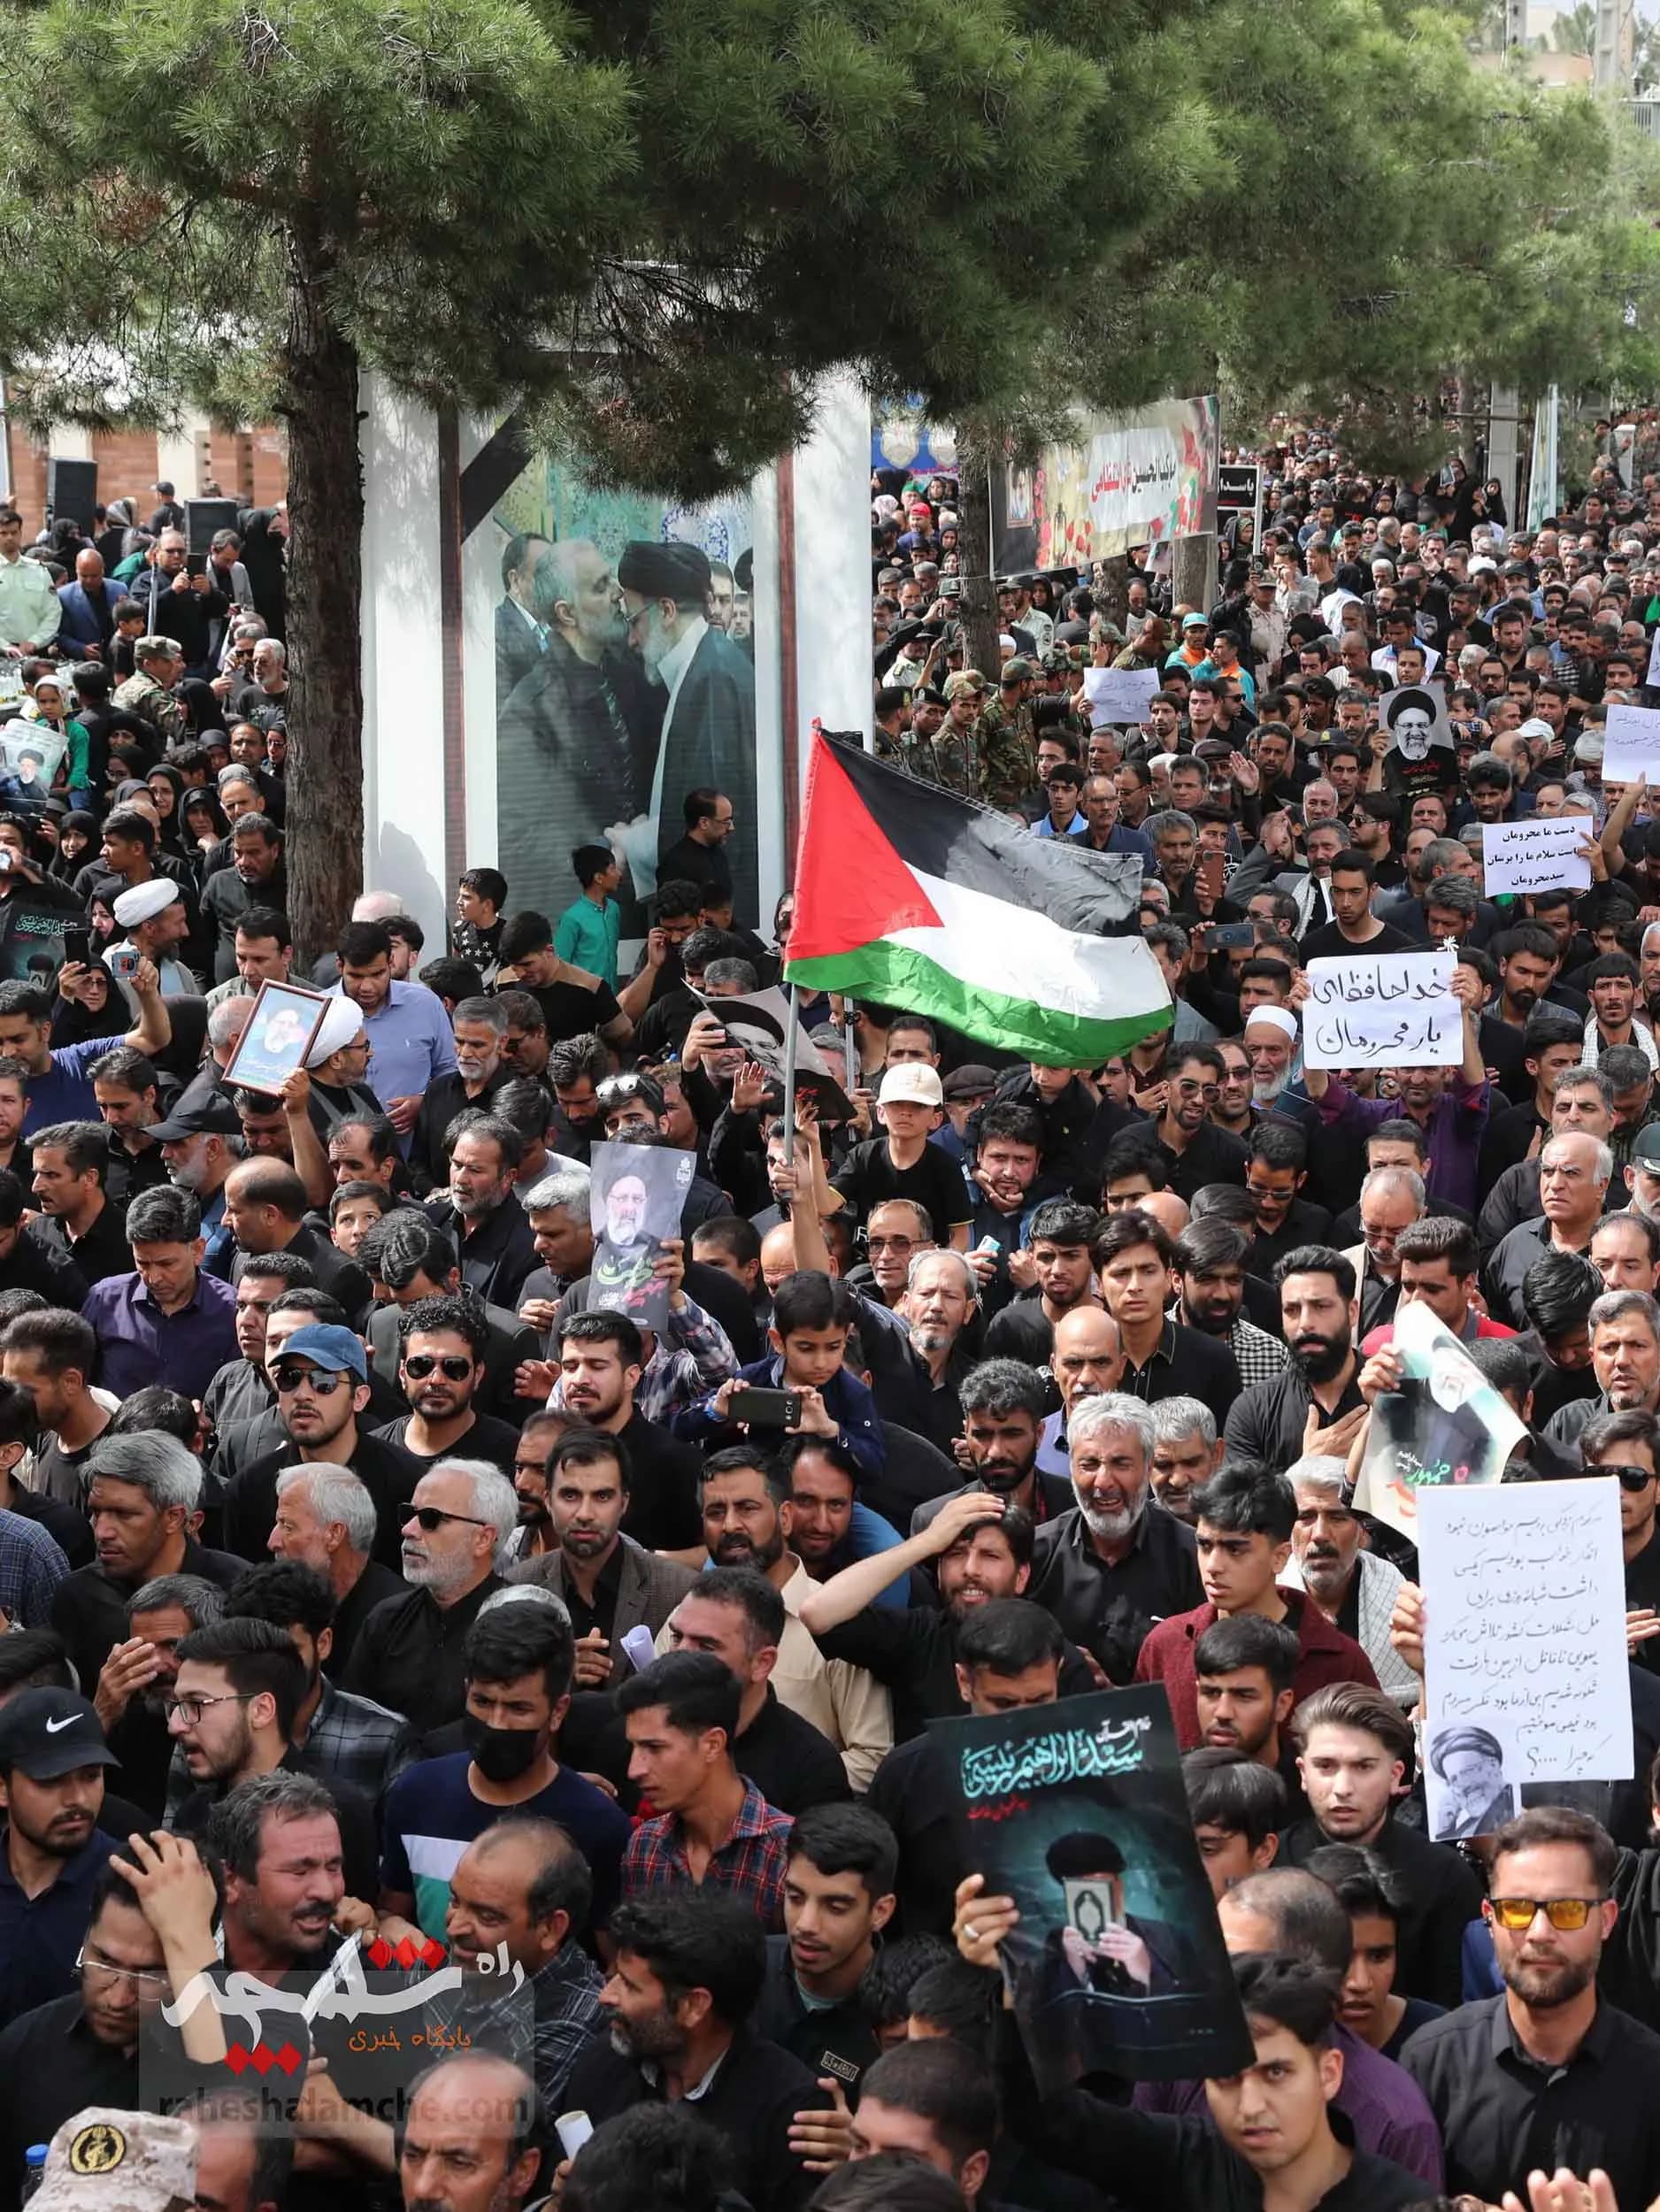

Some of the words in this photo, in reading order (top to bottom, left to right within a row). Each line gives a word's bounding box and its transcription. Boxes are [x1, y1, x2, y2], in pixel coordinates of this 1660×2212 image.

[1502, 830, 1541, 842] محرومان
[1554, 826, 1575, 835] دست
[1487, 855, 1513, 865] برسان
[1515, 853, 1524, 864] را
[1536, 850, 1556, 862] سلام
[1313, 972, 1344, 1004] ای
[1345, 964, 1448, 1002] خداحافظ
[1316, 1017, 1410, 1058] محرومان
[1409, 1016, 1441, 1054] یار
[1548, 1575, 1599, 1600] داشت
